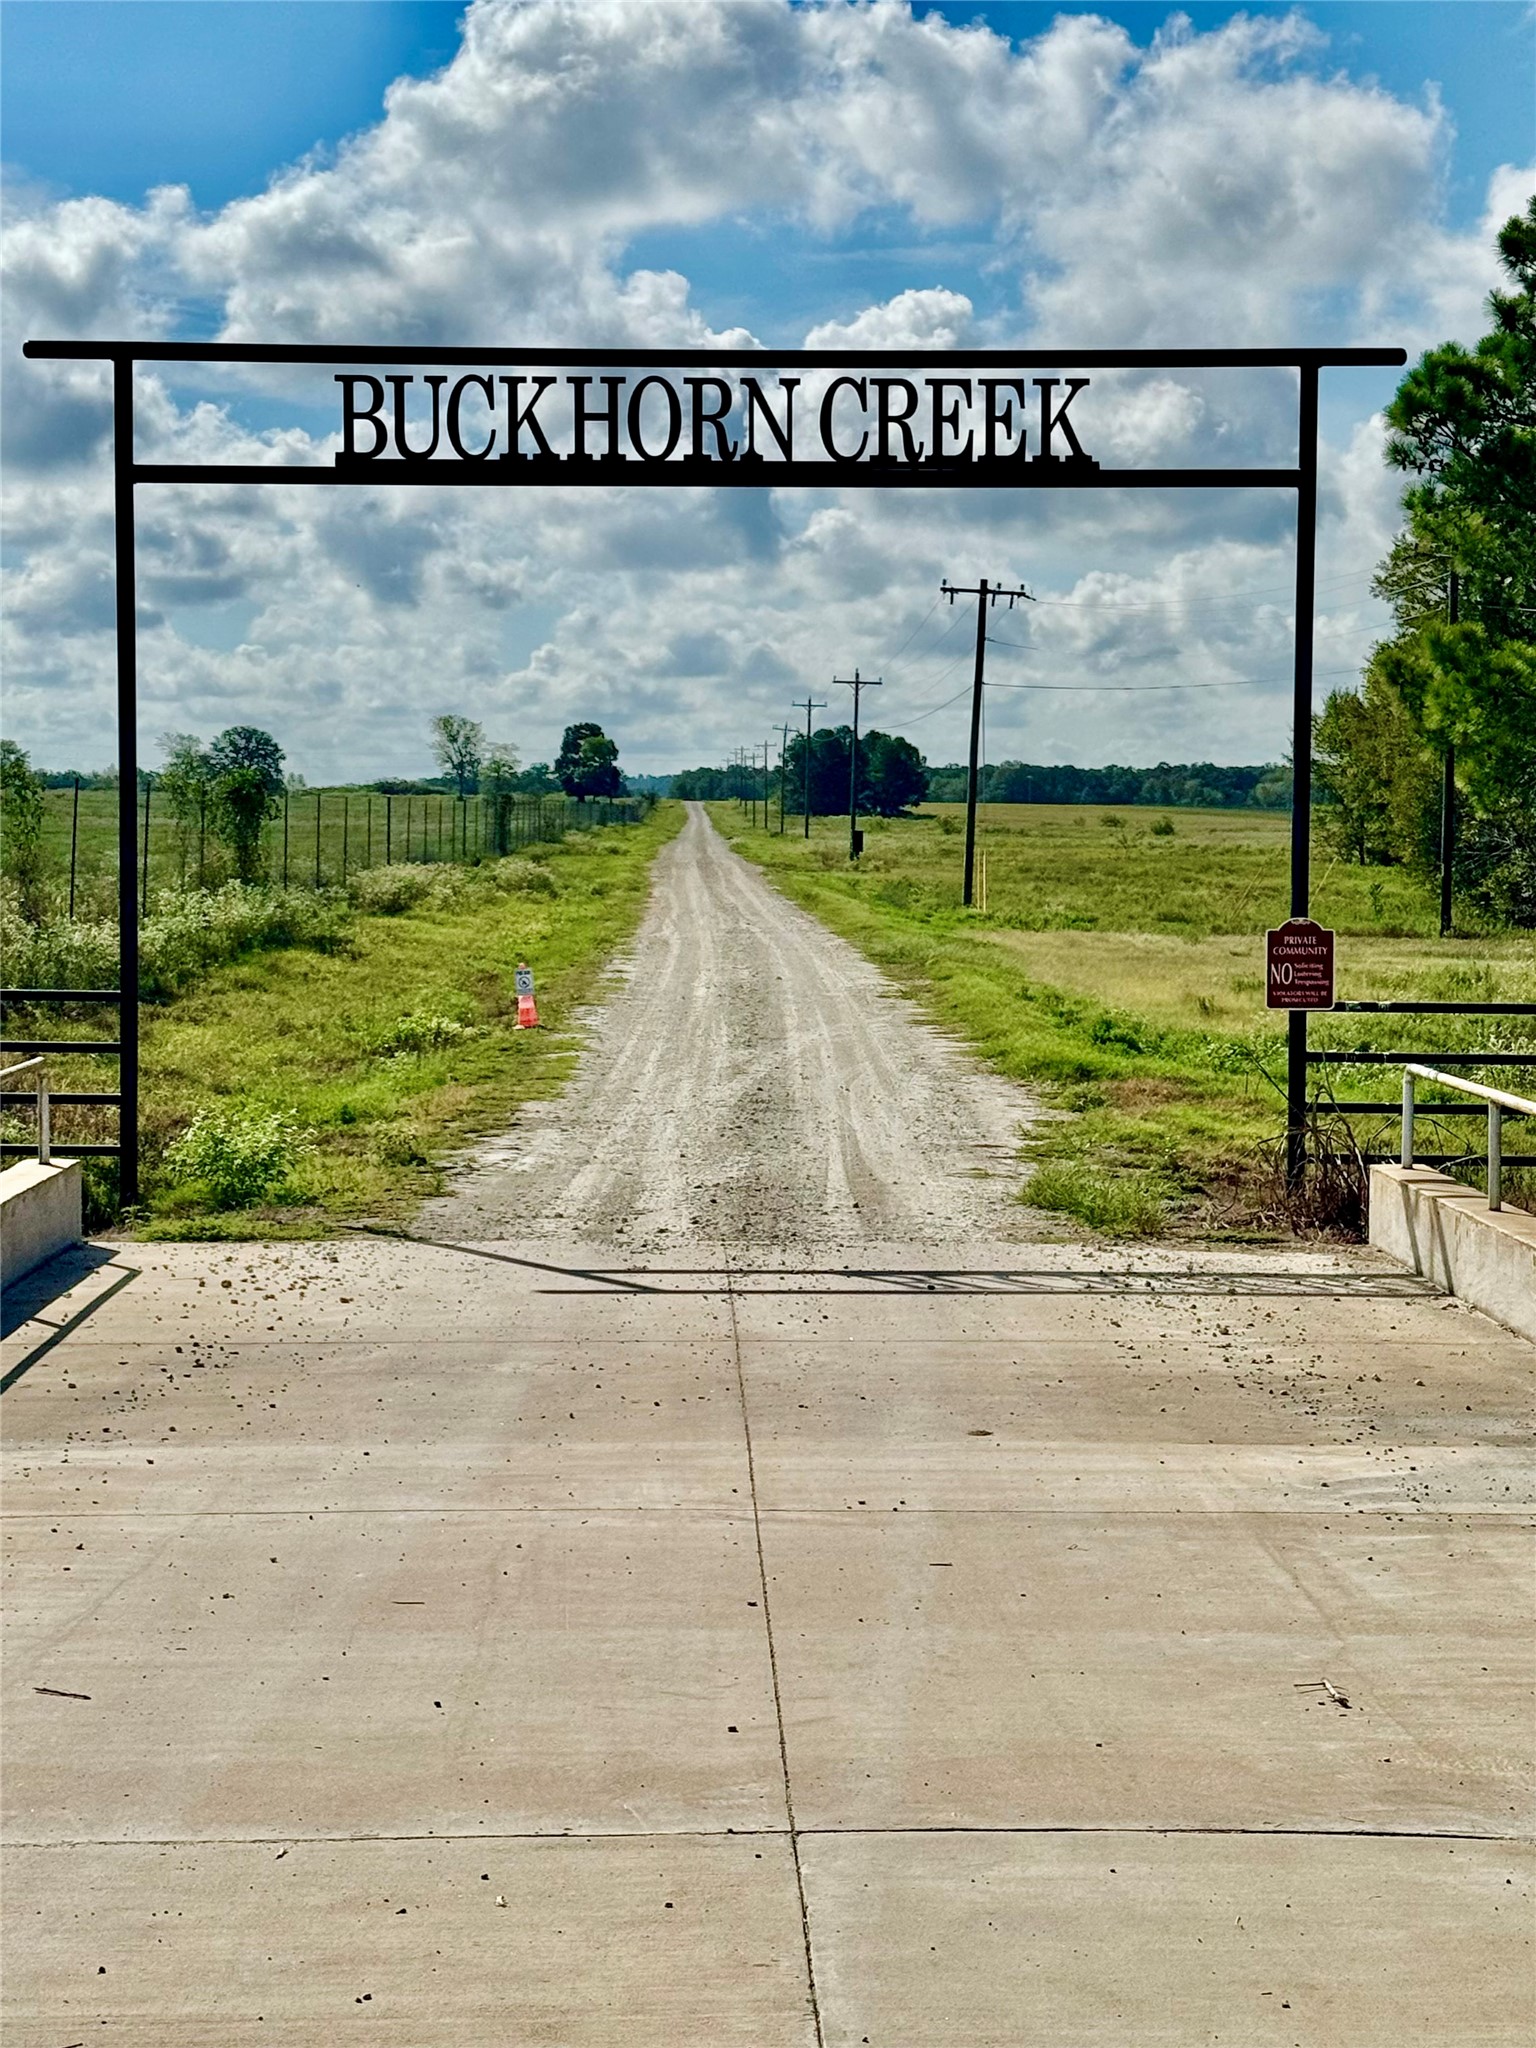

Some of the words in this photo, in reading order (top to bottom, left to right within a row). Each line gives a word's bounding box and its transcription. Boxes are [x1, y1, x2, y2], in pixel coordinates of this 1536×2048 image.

[334, 374, 800, 463] BUCKHORN
[819, 377, 1092, 464] CREEK
[1284, 936, 1317, 945] PRIVATE
[1273, 947, 1328, 955] COMMUNITY
[1271, 963, 1293, 985] NO
